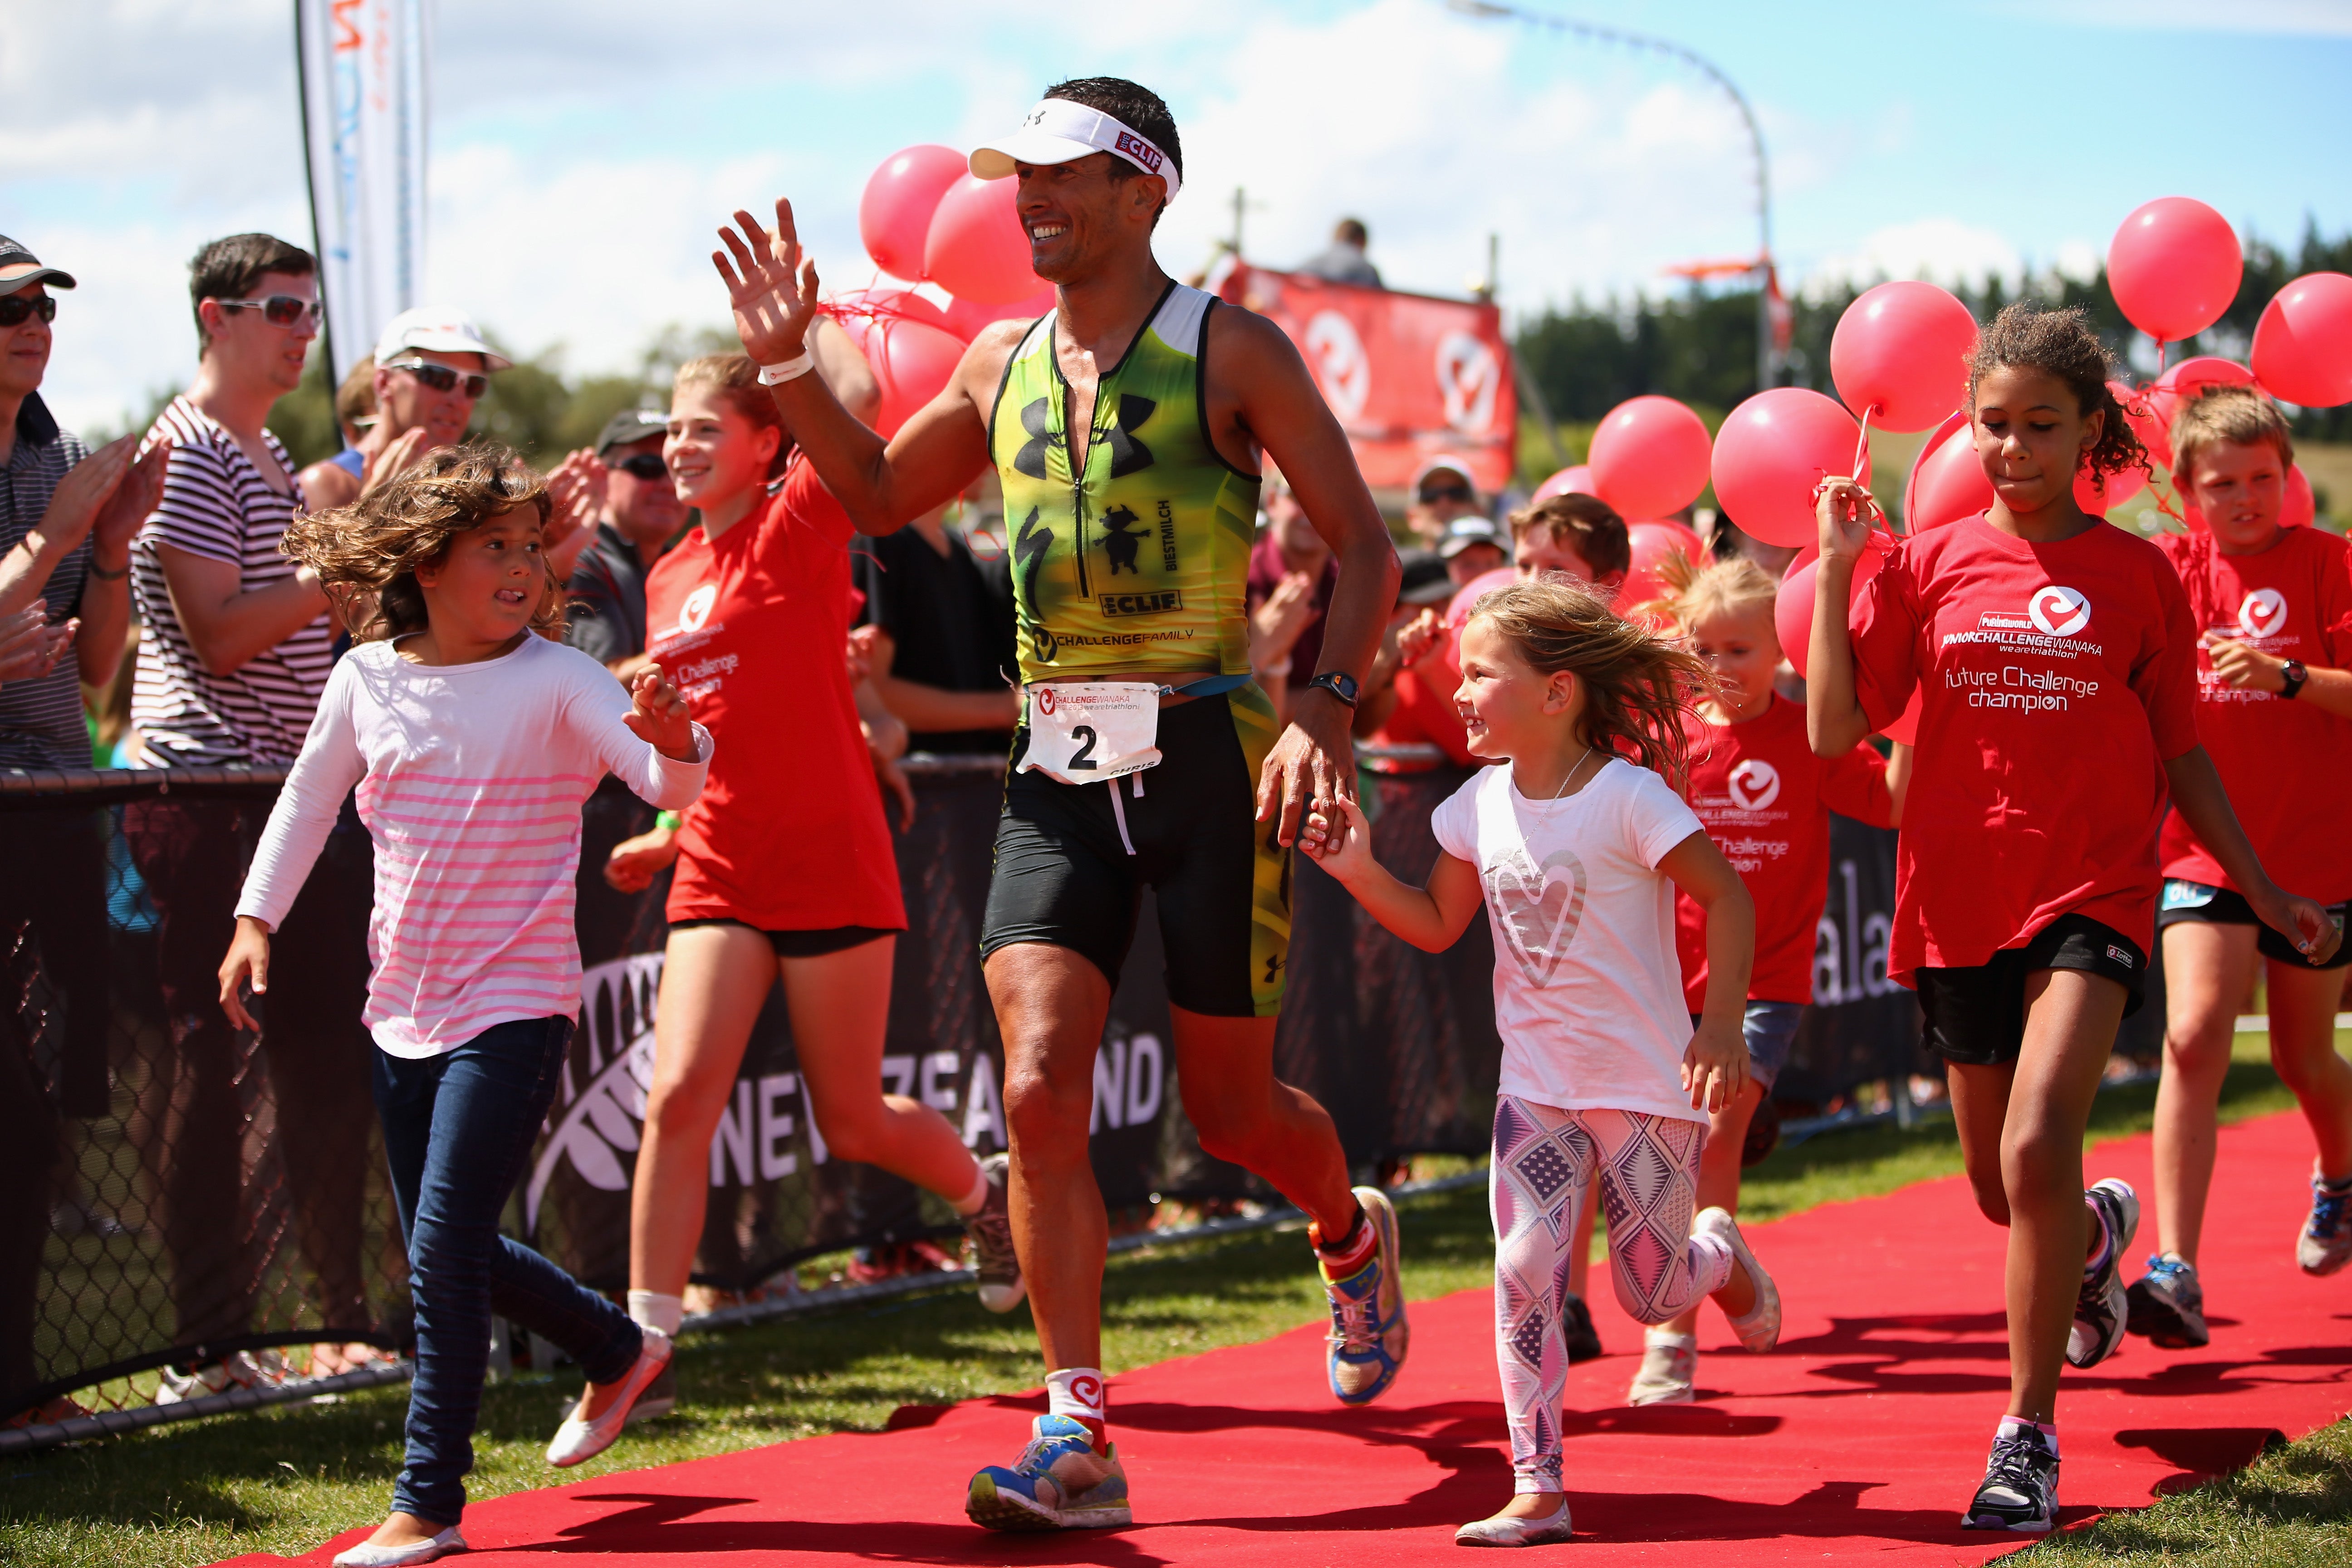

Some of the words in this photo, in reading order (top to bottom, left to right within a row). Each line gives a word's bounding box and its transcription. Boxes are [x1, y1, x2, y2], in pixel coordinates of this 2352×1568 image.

[1119, 134, 1131, 149] BAR
[1129, 140, 1161, 168] CLIF
[1157, 500, 1177, 572] BIESTMILCH
[1117, 593, 1175, 613] CLIF
[2031, 646, 2078, 659] triathlon!
[1946, 667, 1998, 689] future
[2003, 666, 2099, 698] Challenge
[1969, 687, 2068, 715] champion
[1067, 725, 1098, 770] 2
